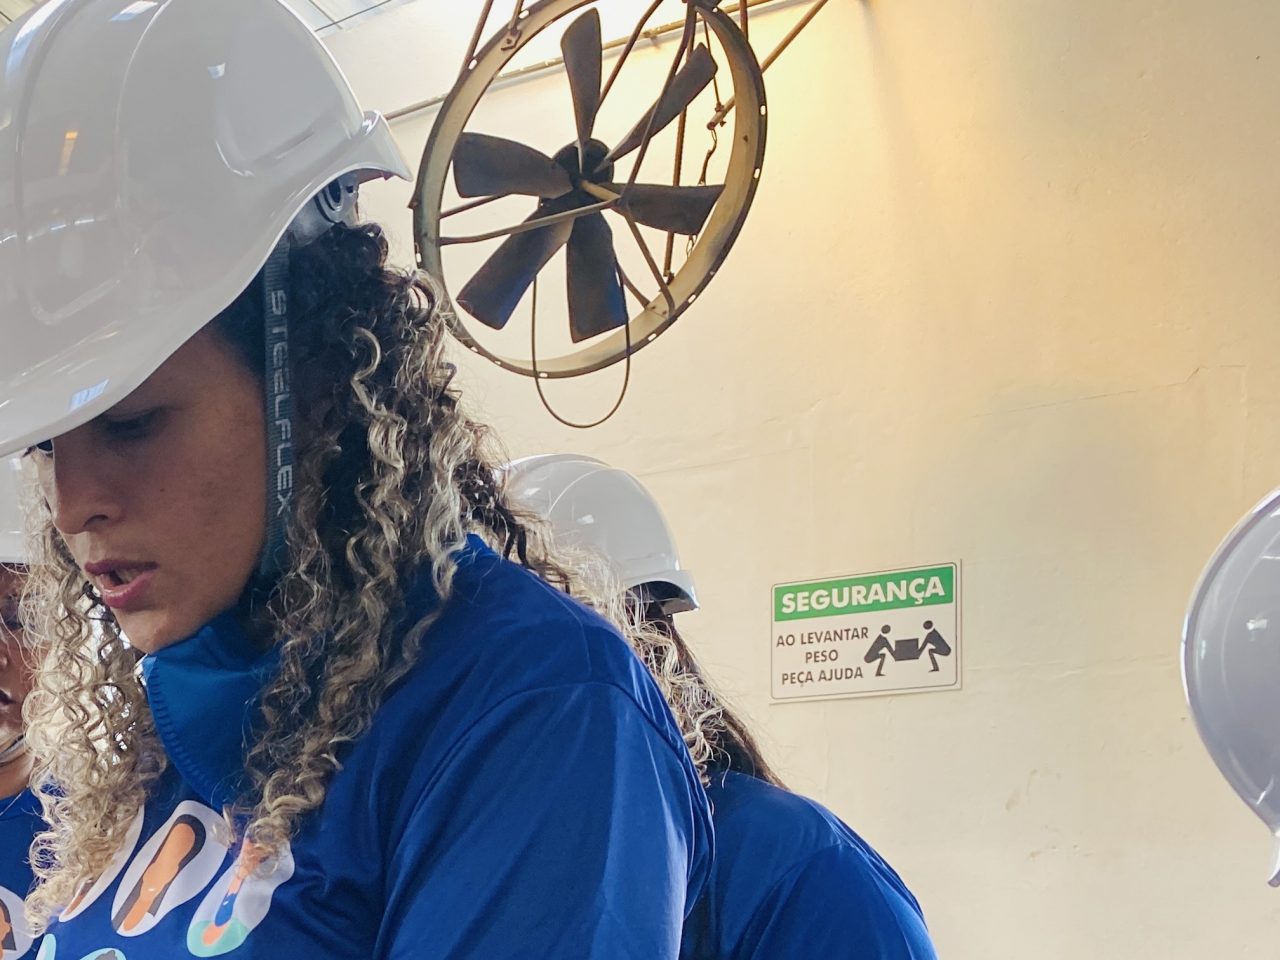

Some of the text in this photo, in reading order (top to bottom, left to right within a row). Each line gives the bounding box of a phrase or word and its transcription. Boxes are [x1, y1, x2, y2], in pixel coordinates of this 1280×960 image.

[271, 289, 293, 516] STEELFLEX
[781, 576, 945, 614] SEGURANÇA
[776, 626, 869, 647] AO LEVANTAR
[805, 649, 839, 664] PESO
[781, 666, 864, 687] PEÇA AJUDA
